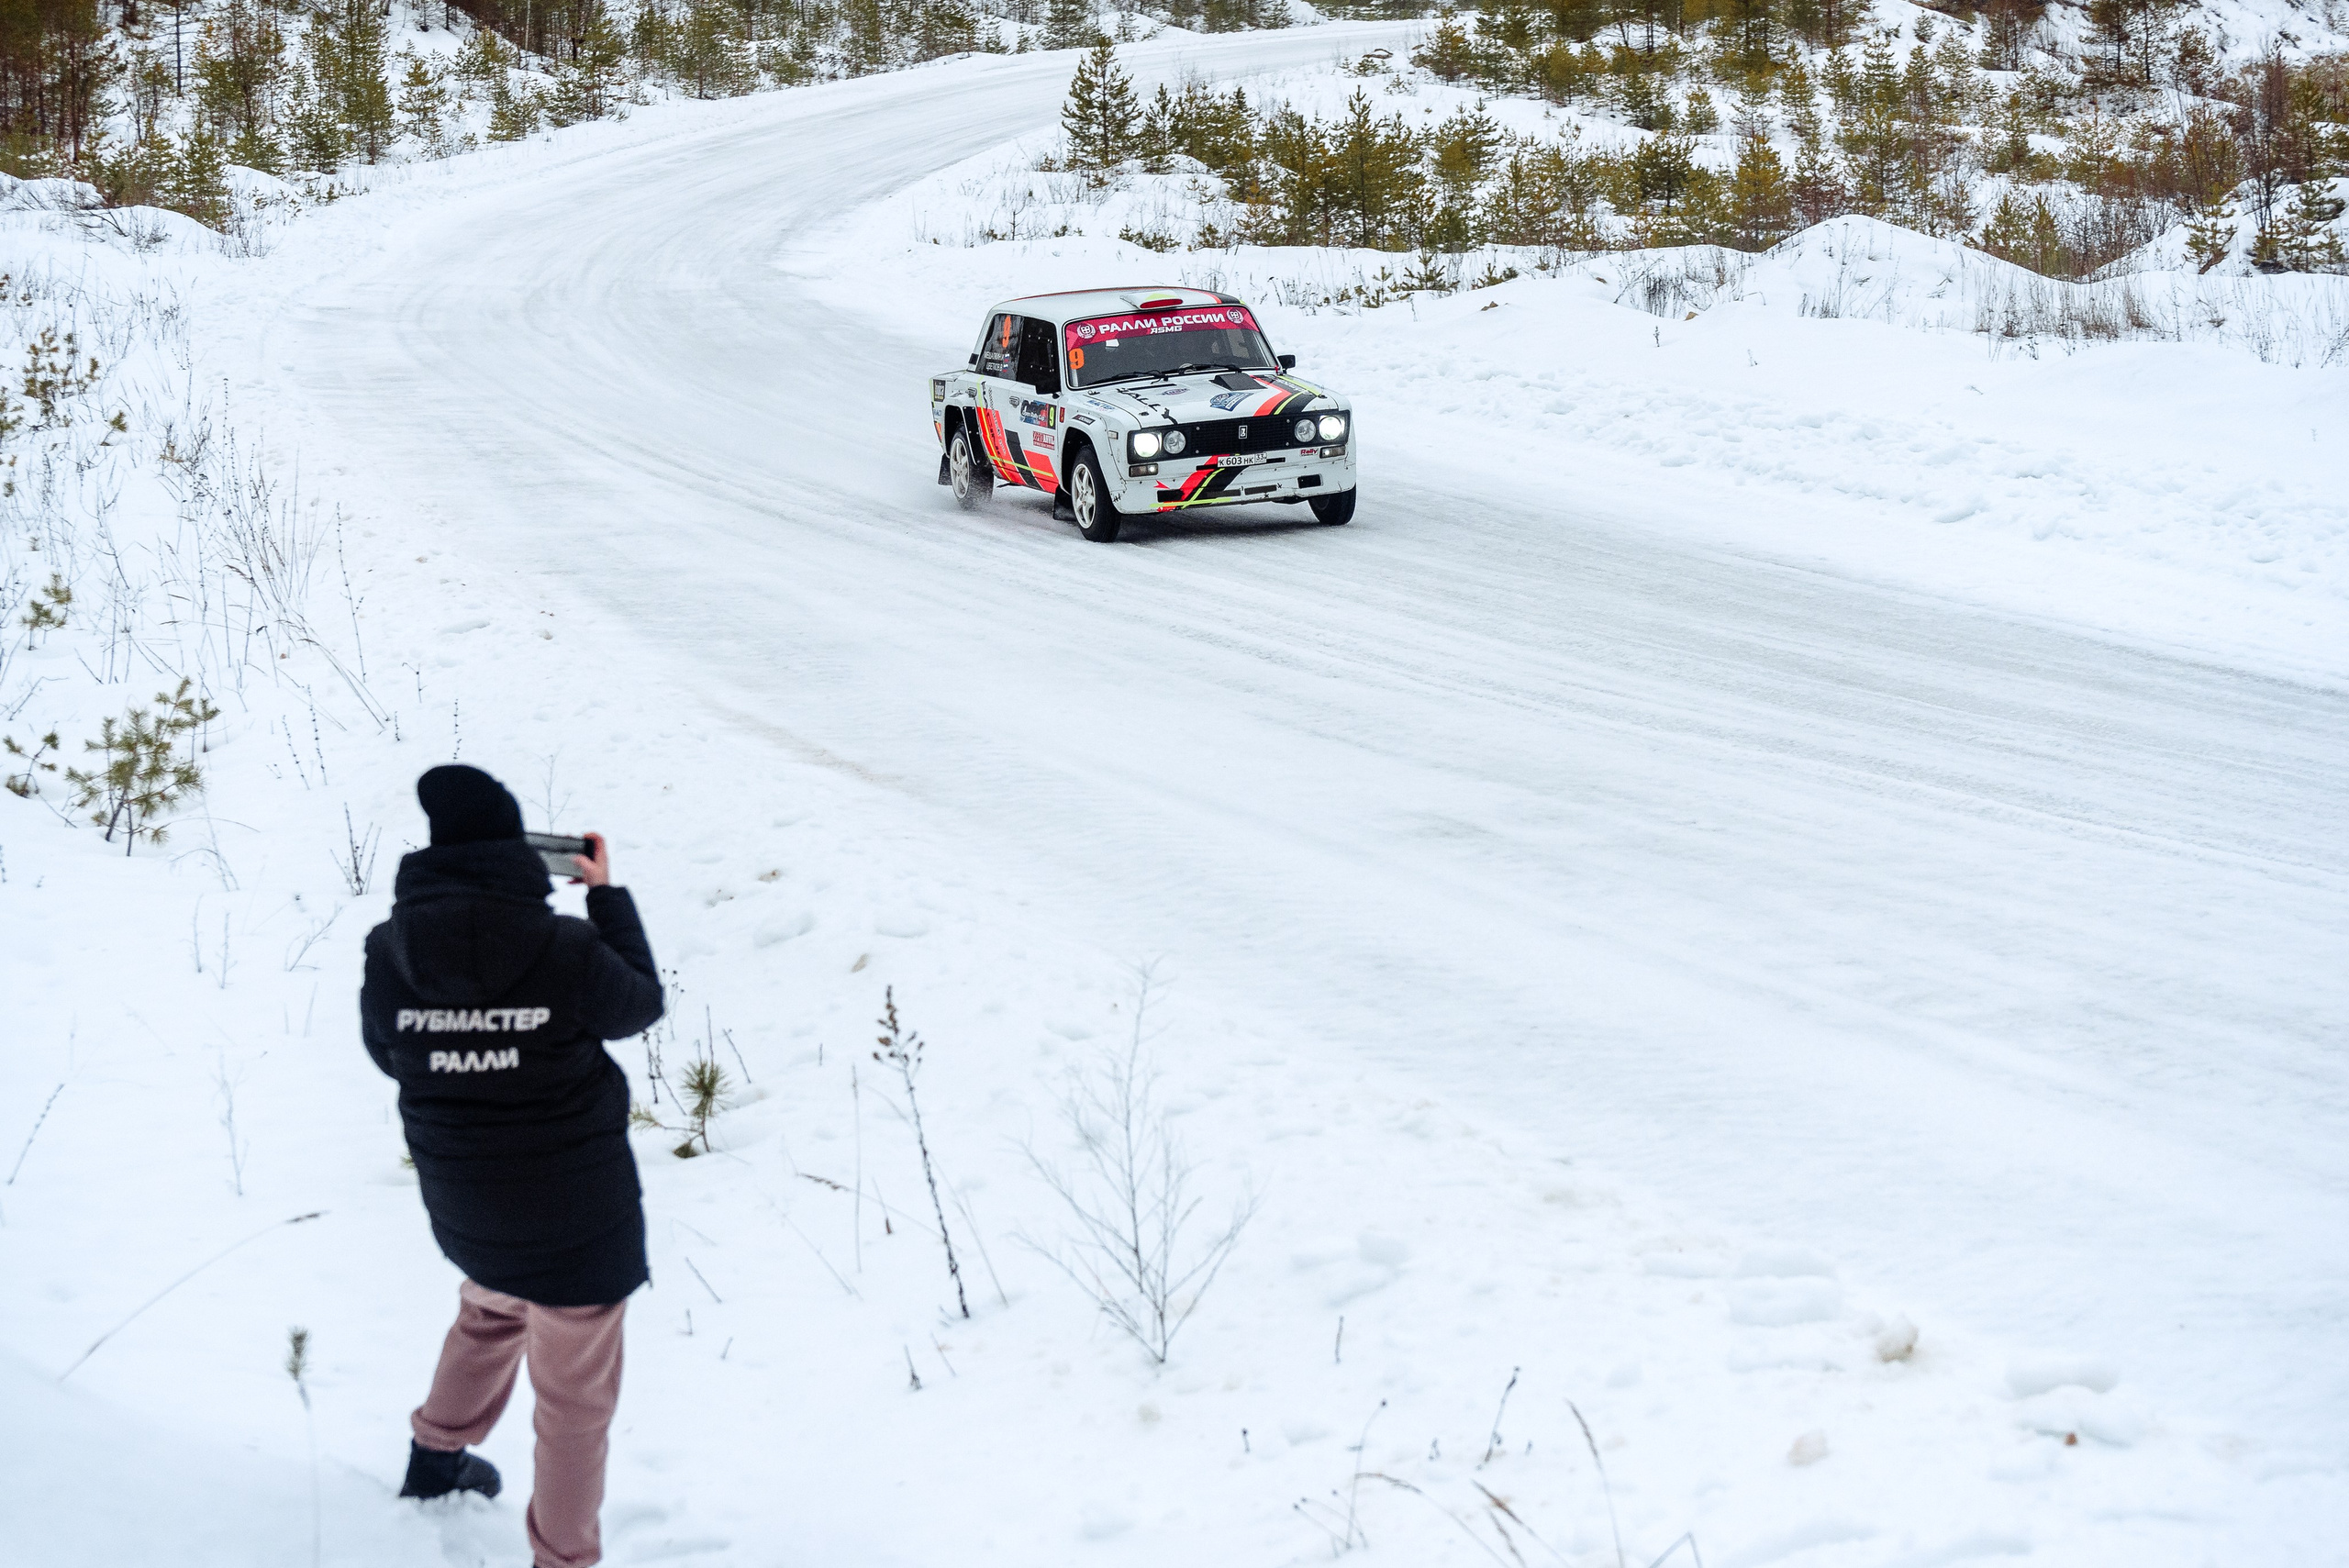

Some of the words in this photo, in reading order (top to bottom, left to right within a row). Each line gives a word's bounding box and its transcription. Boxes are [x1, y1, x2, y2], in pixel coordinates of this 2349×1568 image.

[1002, 315, 1011, 349] 9
[1098, 318, 1157, 335] РАЛЛИ
[1161, 313, 1226, 327] РОССИИ
[1069, 348, 1085, 370] 9
[1049, 406, 1055, 427] 9
[1226, 457, 1242, 466] 603
[396, 1006, 551, 1033] РУБМАСТЕР
[429, 1047, 520, 1073] РАЛЛИ
